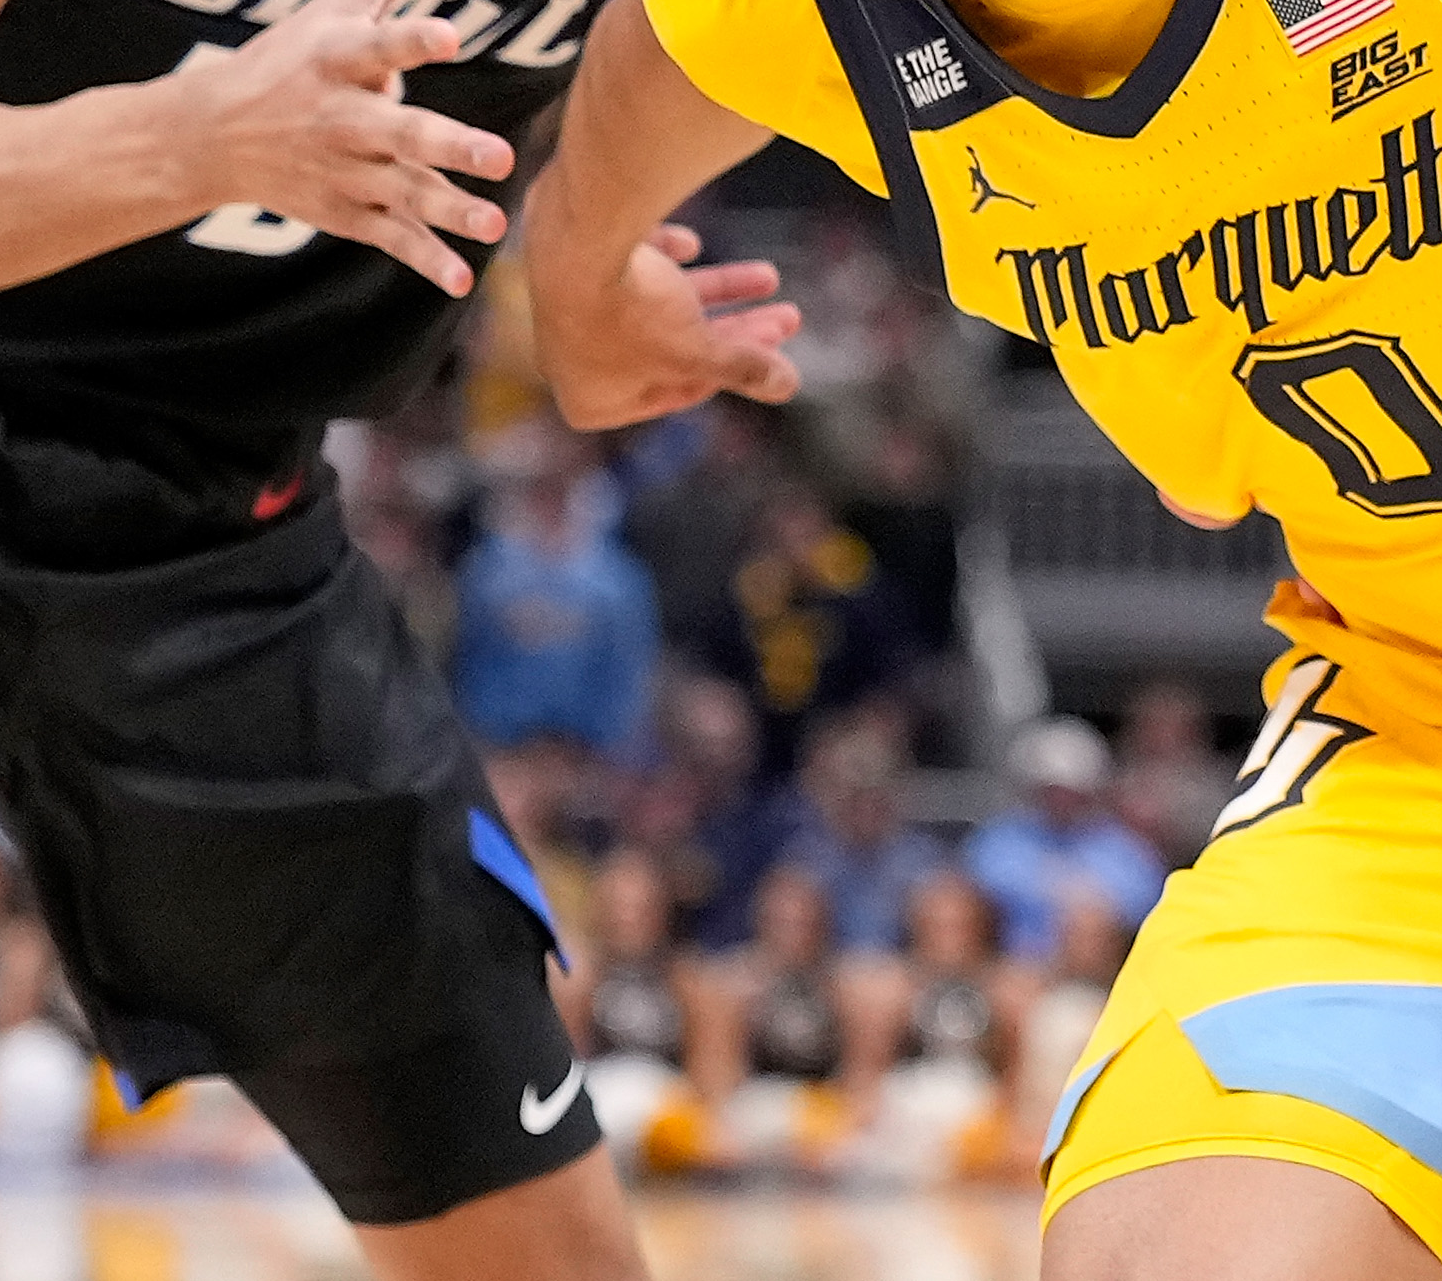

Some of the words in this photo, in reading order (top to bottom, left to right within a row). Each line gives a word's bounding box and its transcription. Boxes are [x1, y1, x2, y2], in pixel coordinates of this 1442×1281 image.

[906, 37, 953, 79] THE
[1330, 30, 1398, 85] BIG
[1331, 41, 1429, 108] EAST
